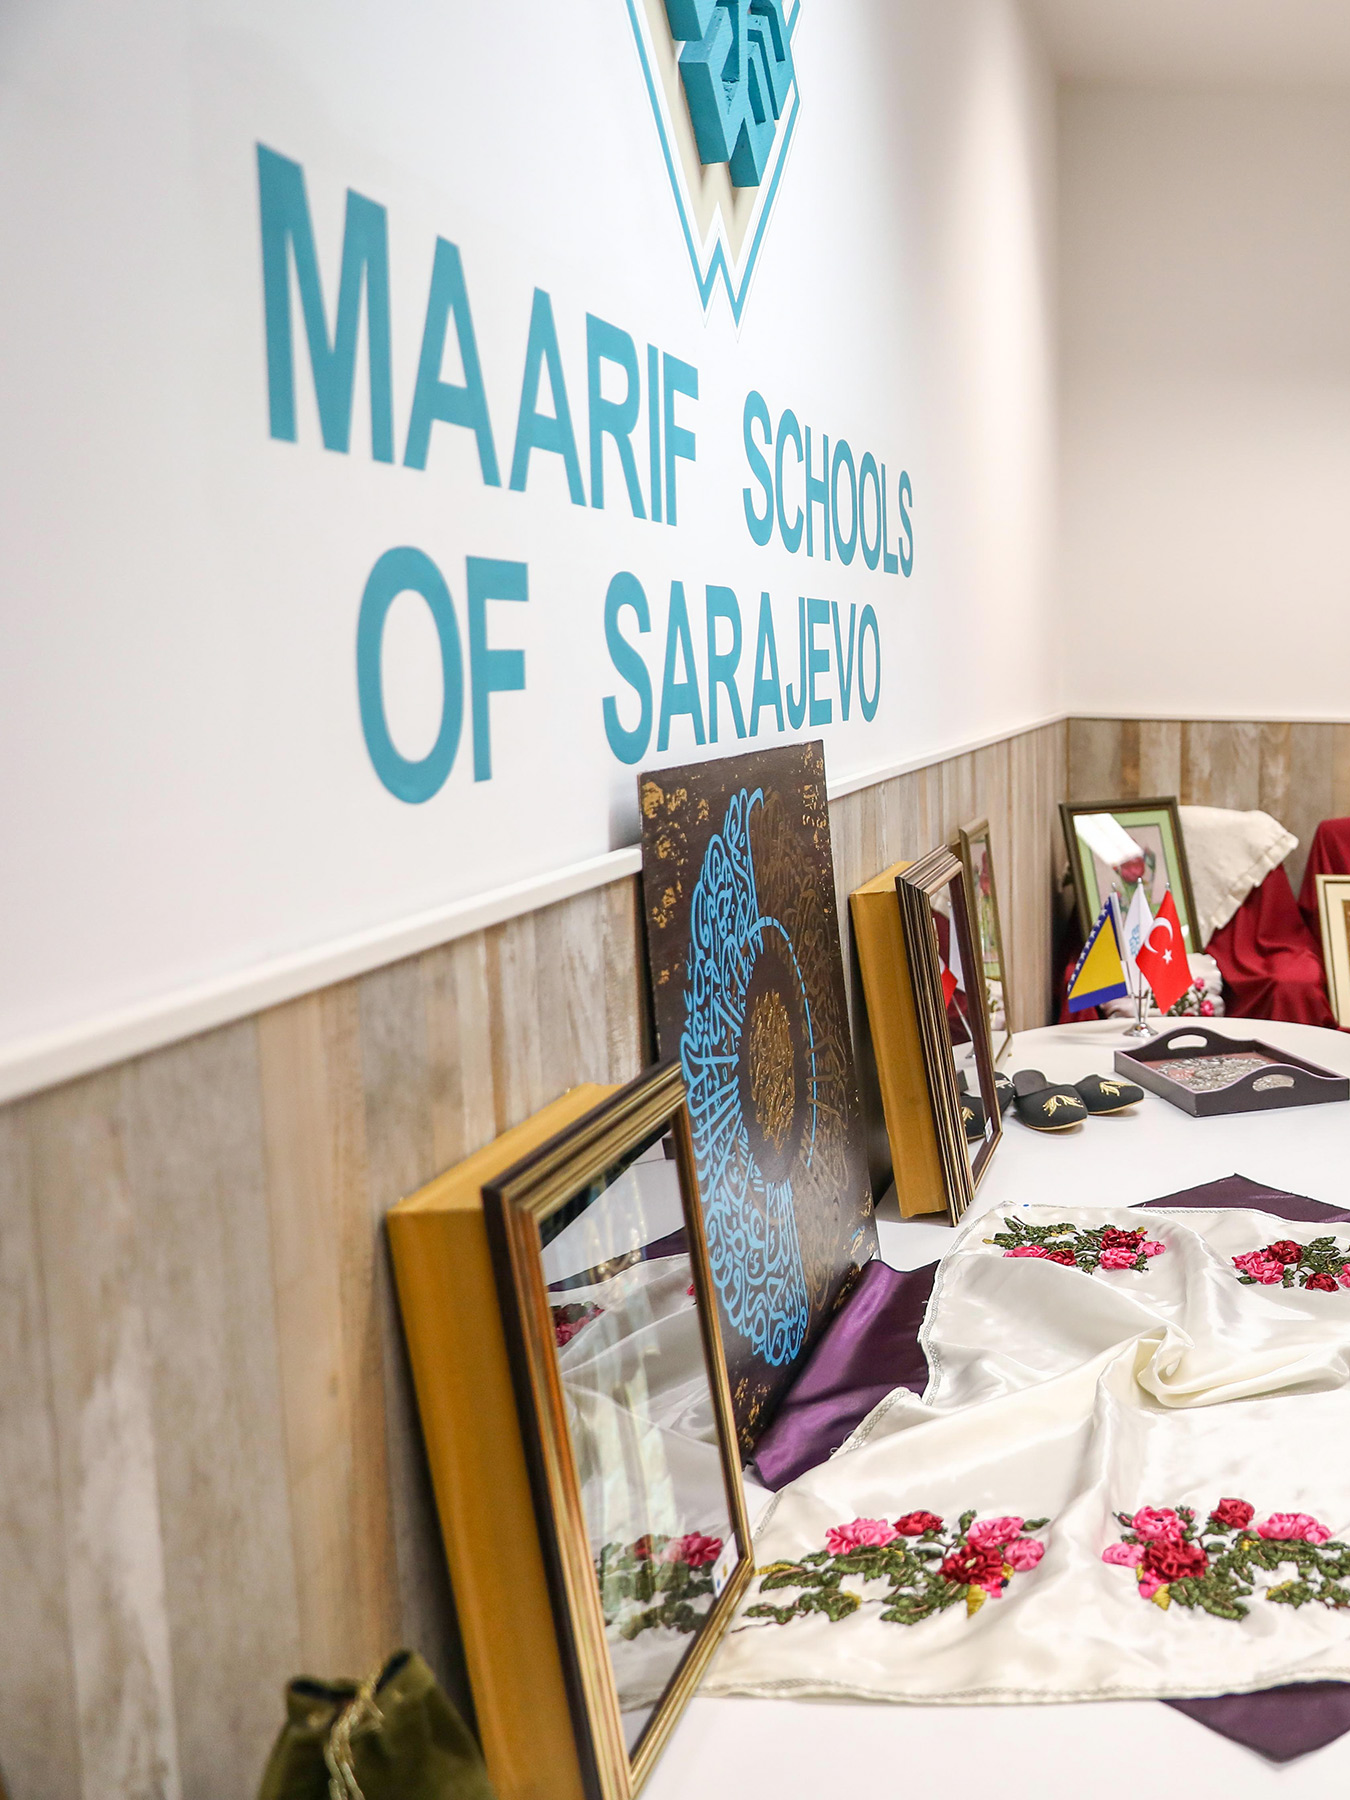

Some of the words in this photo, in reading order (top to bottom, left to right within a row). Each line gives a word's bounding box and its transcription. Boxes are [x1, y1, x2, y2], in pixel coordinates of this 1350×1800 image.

[256, 142, 699, 527] MAARIF
[742, 389, 914, 578] SCHOOLS
[356, 545, 530, 805] OF
[602, 570, 881, 765] SARAJEVO
